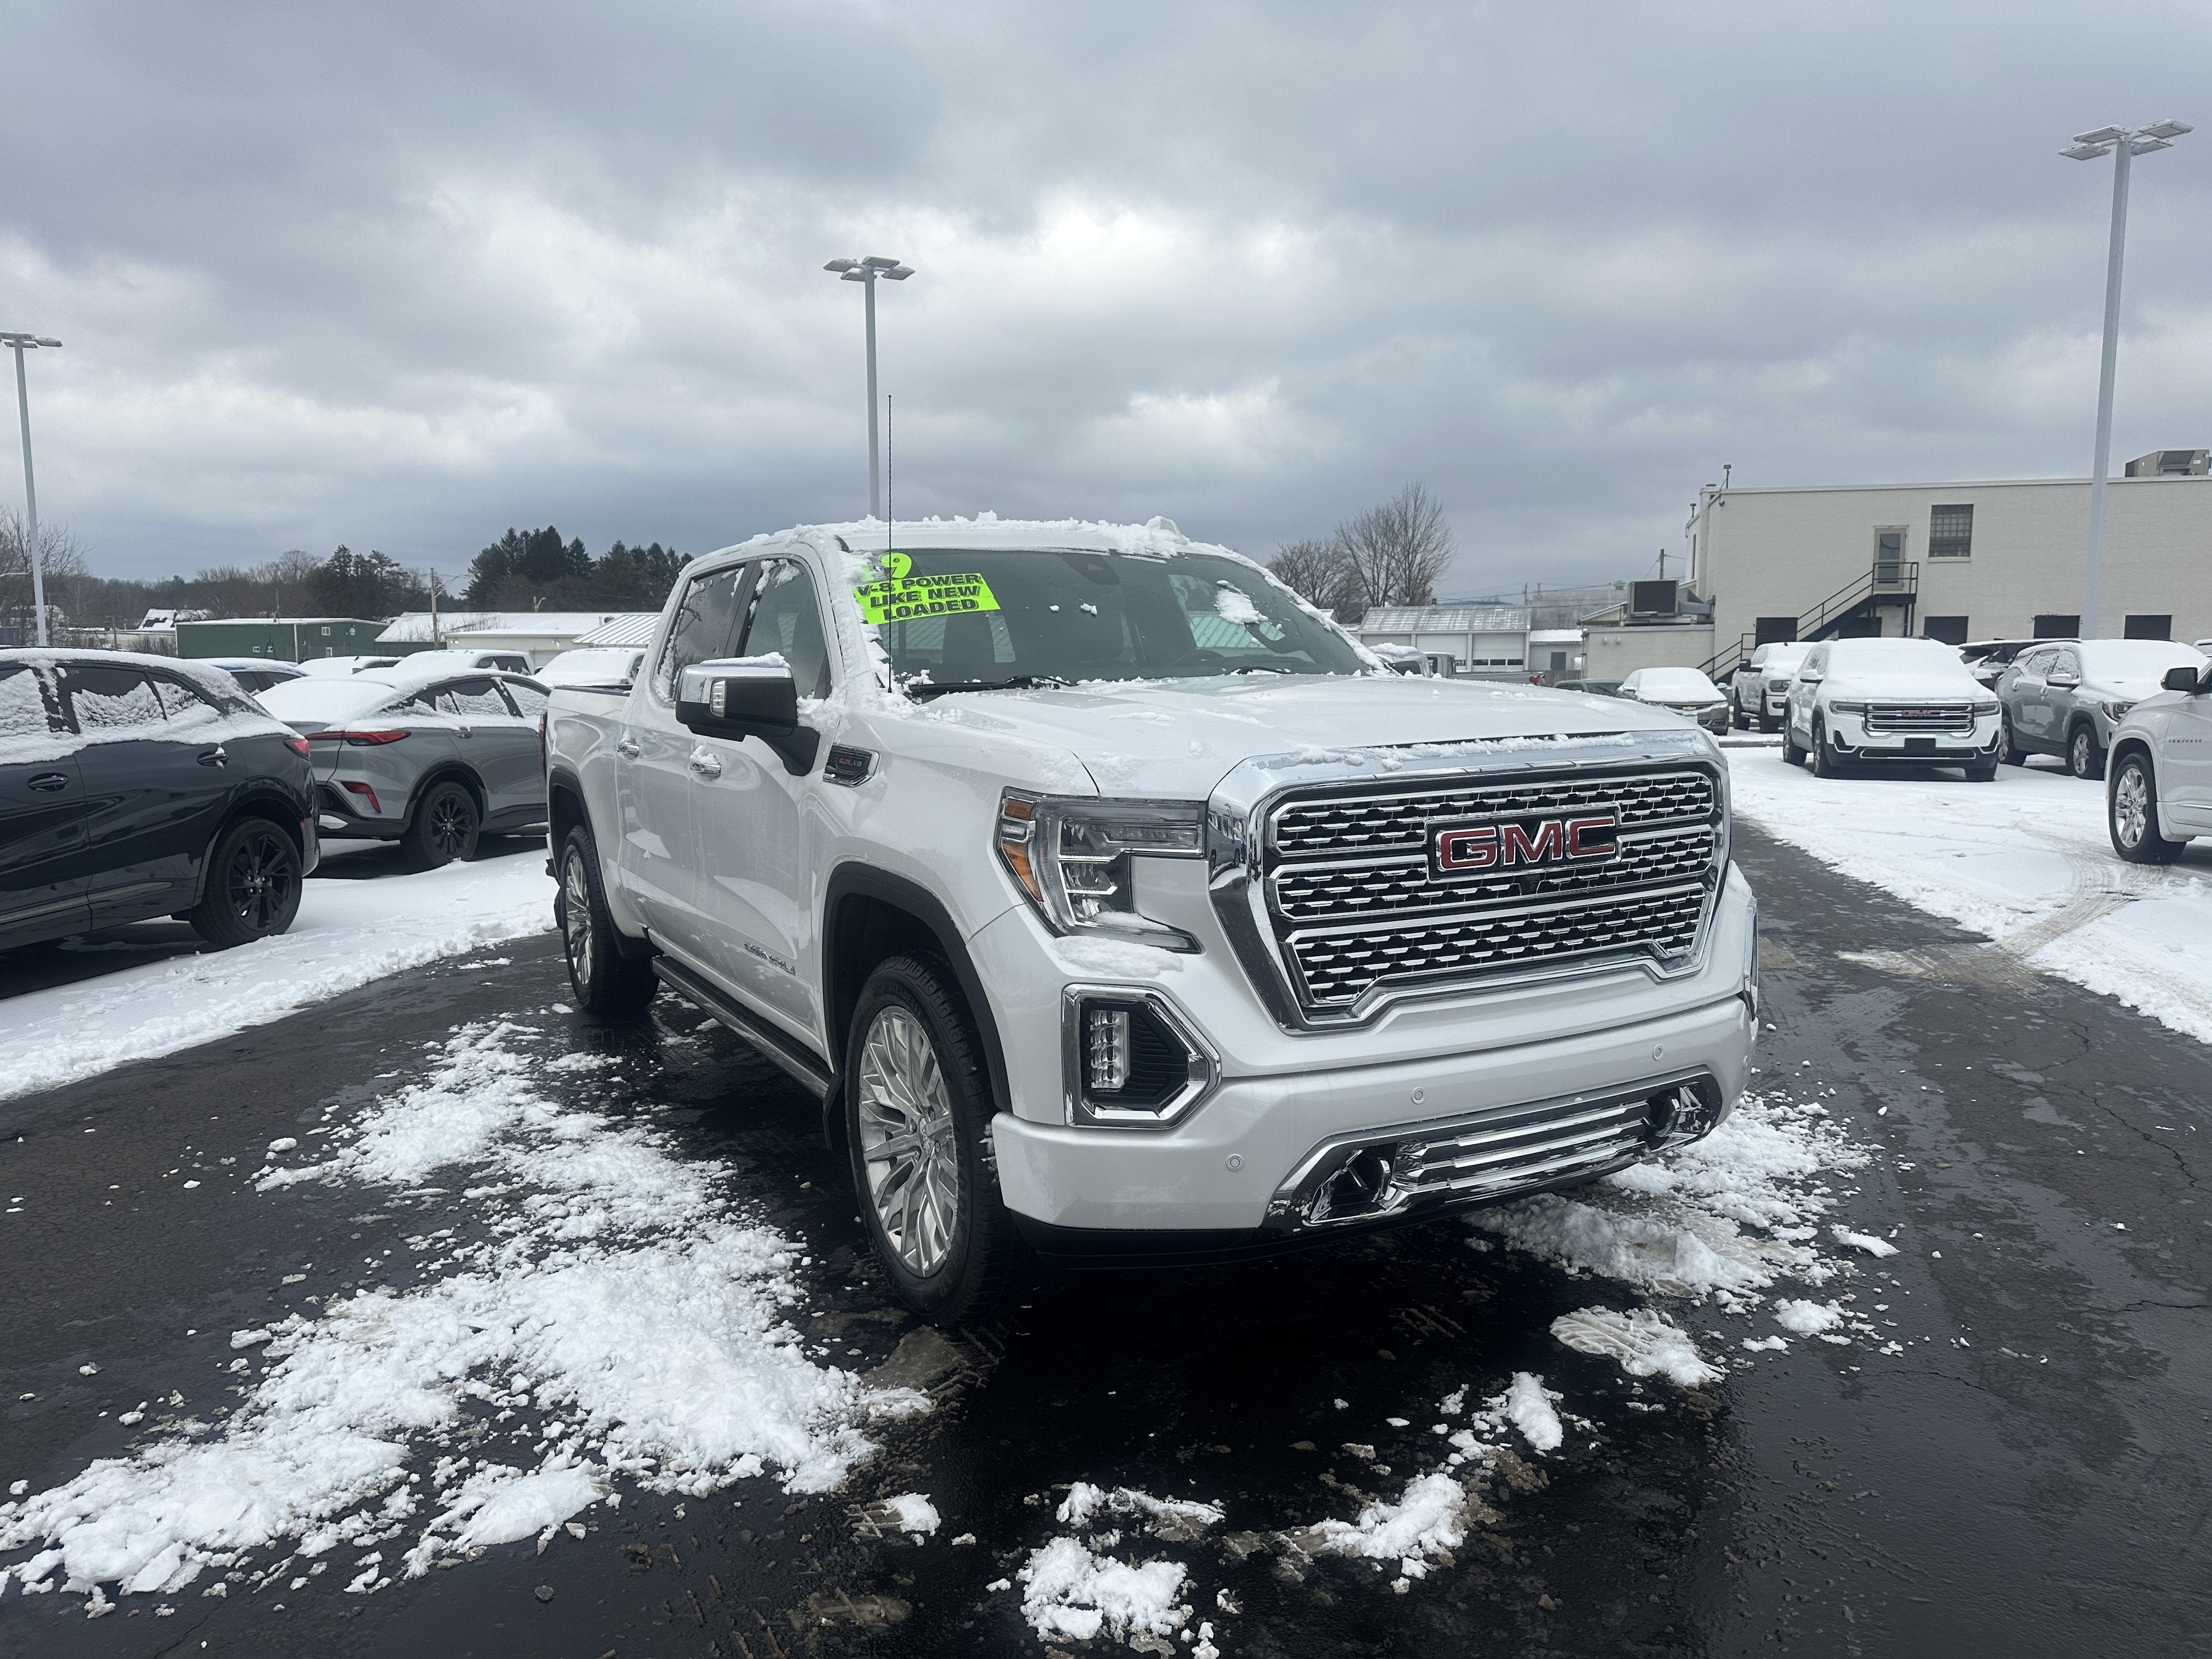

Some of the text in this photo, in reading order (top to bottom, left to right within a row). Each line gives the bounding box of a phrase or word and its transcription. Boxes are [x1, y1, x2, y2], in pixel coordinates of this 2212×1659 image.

[856, 574, 983, 597] V-8 POWER
[870, 586, 981, 608] LIKE NEW
[883, 599, 979, 621] LOADED
[1435, 815, 1616, 872] GMC
[888, 982, 923, 1018] STEADFAST
